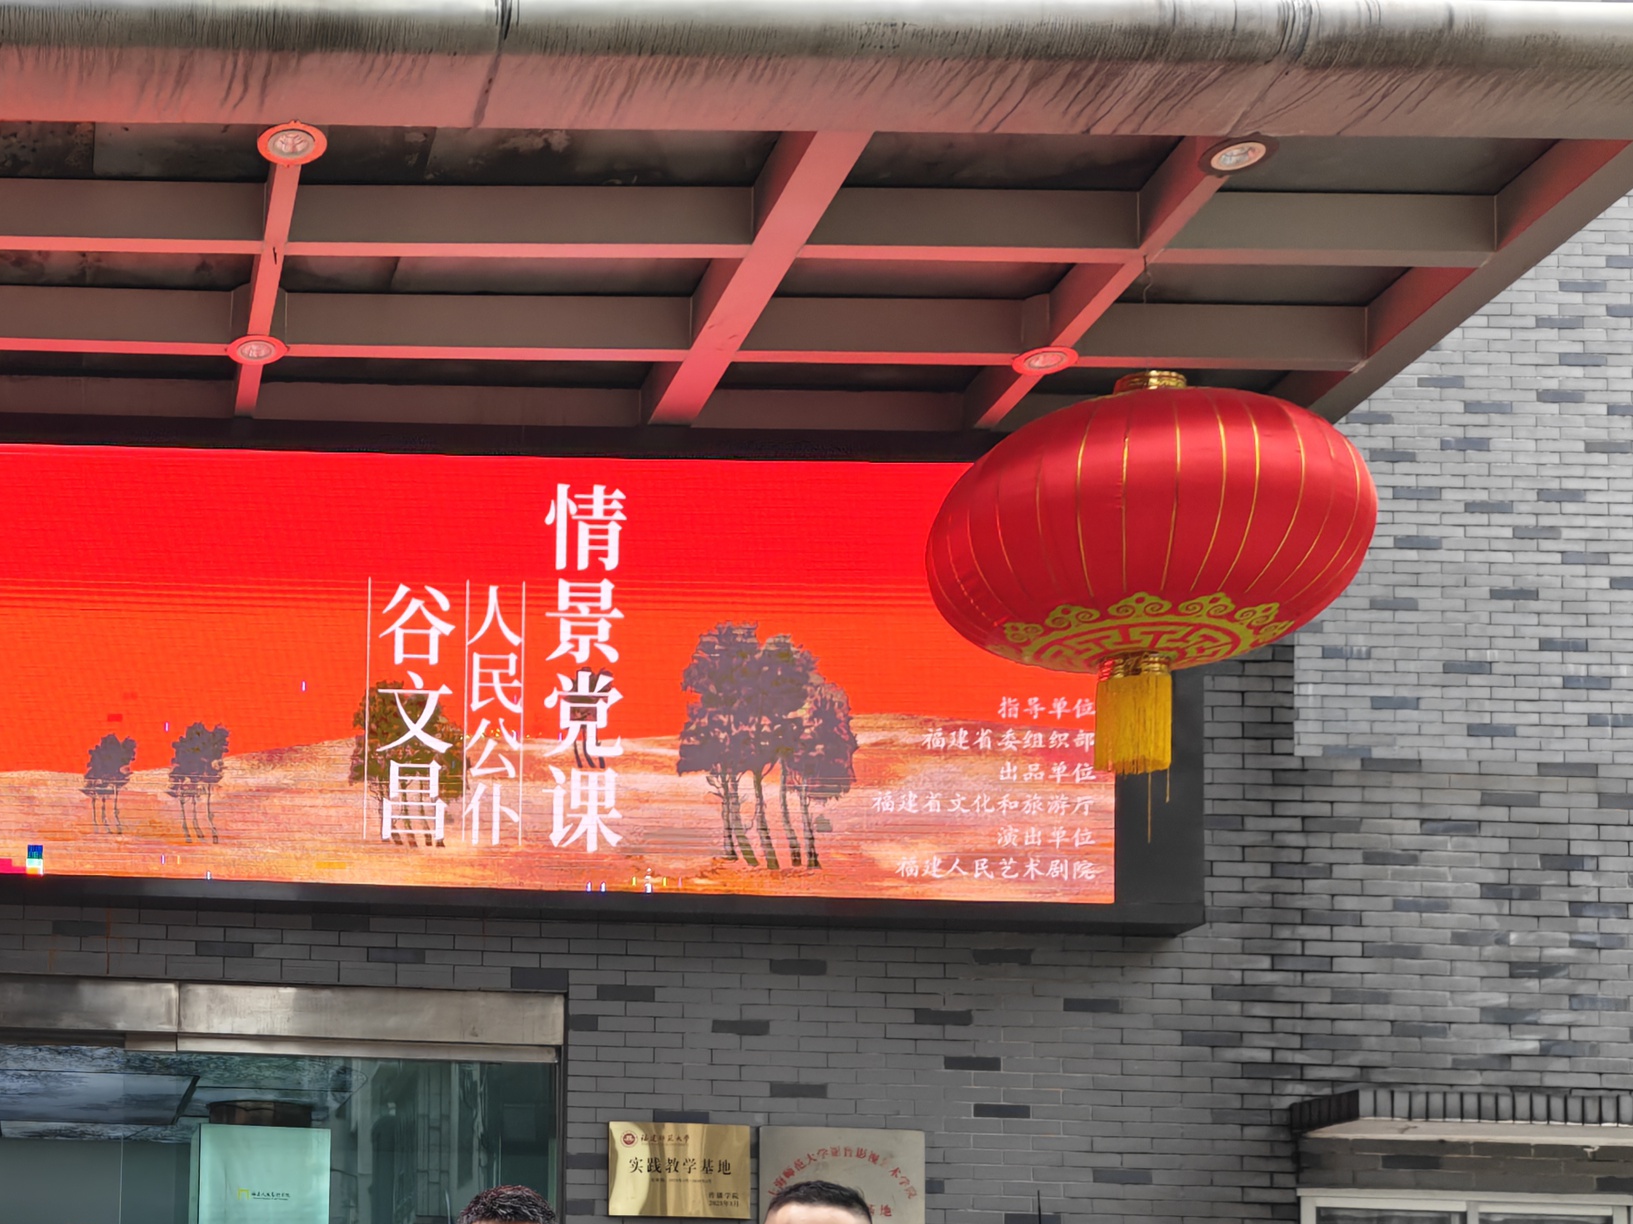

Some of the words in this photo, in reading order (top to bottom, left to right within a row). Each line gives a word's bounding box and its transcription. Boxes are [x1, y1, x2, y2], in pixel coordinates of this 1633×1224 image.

[542, 483, 627, 853] 情景党课
[377, 582, 455, 842] 谷文昌
[462, 585, 523, 845] 人民公仆
[997, 696, 1096, 719] 指导单位
[921, 727, 1095, 752] 福建省委组织部
[998, 761, 1097, 784] 出品单位
[871, 791, 1095, 817] 福建省文化和旅游厅
[997, 825, 1096, 849] 演出单位
[895, 856, 1097, 881] 福建人民艺术剧院
[629, 1156, 732, 1176] 实践教学基地
